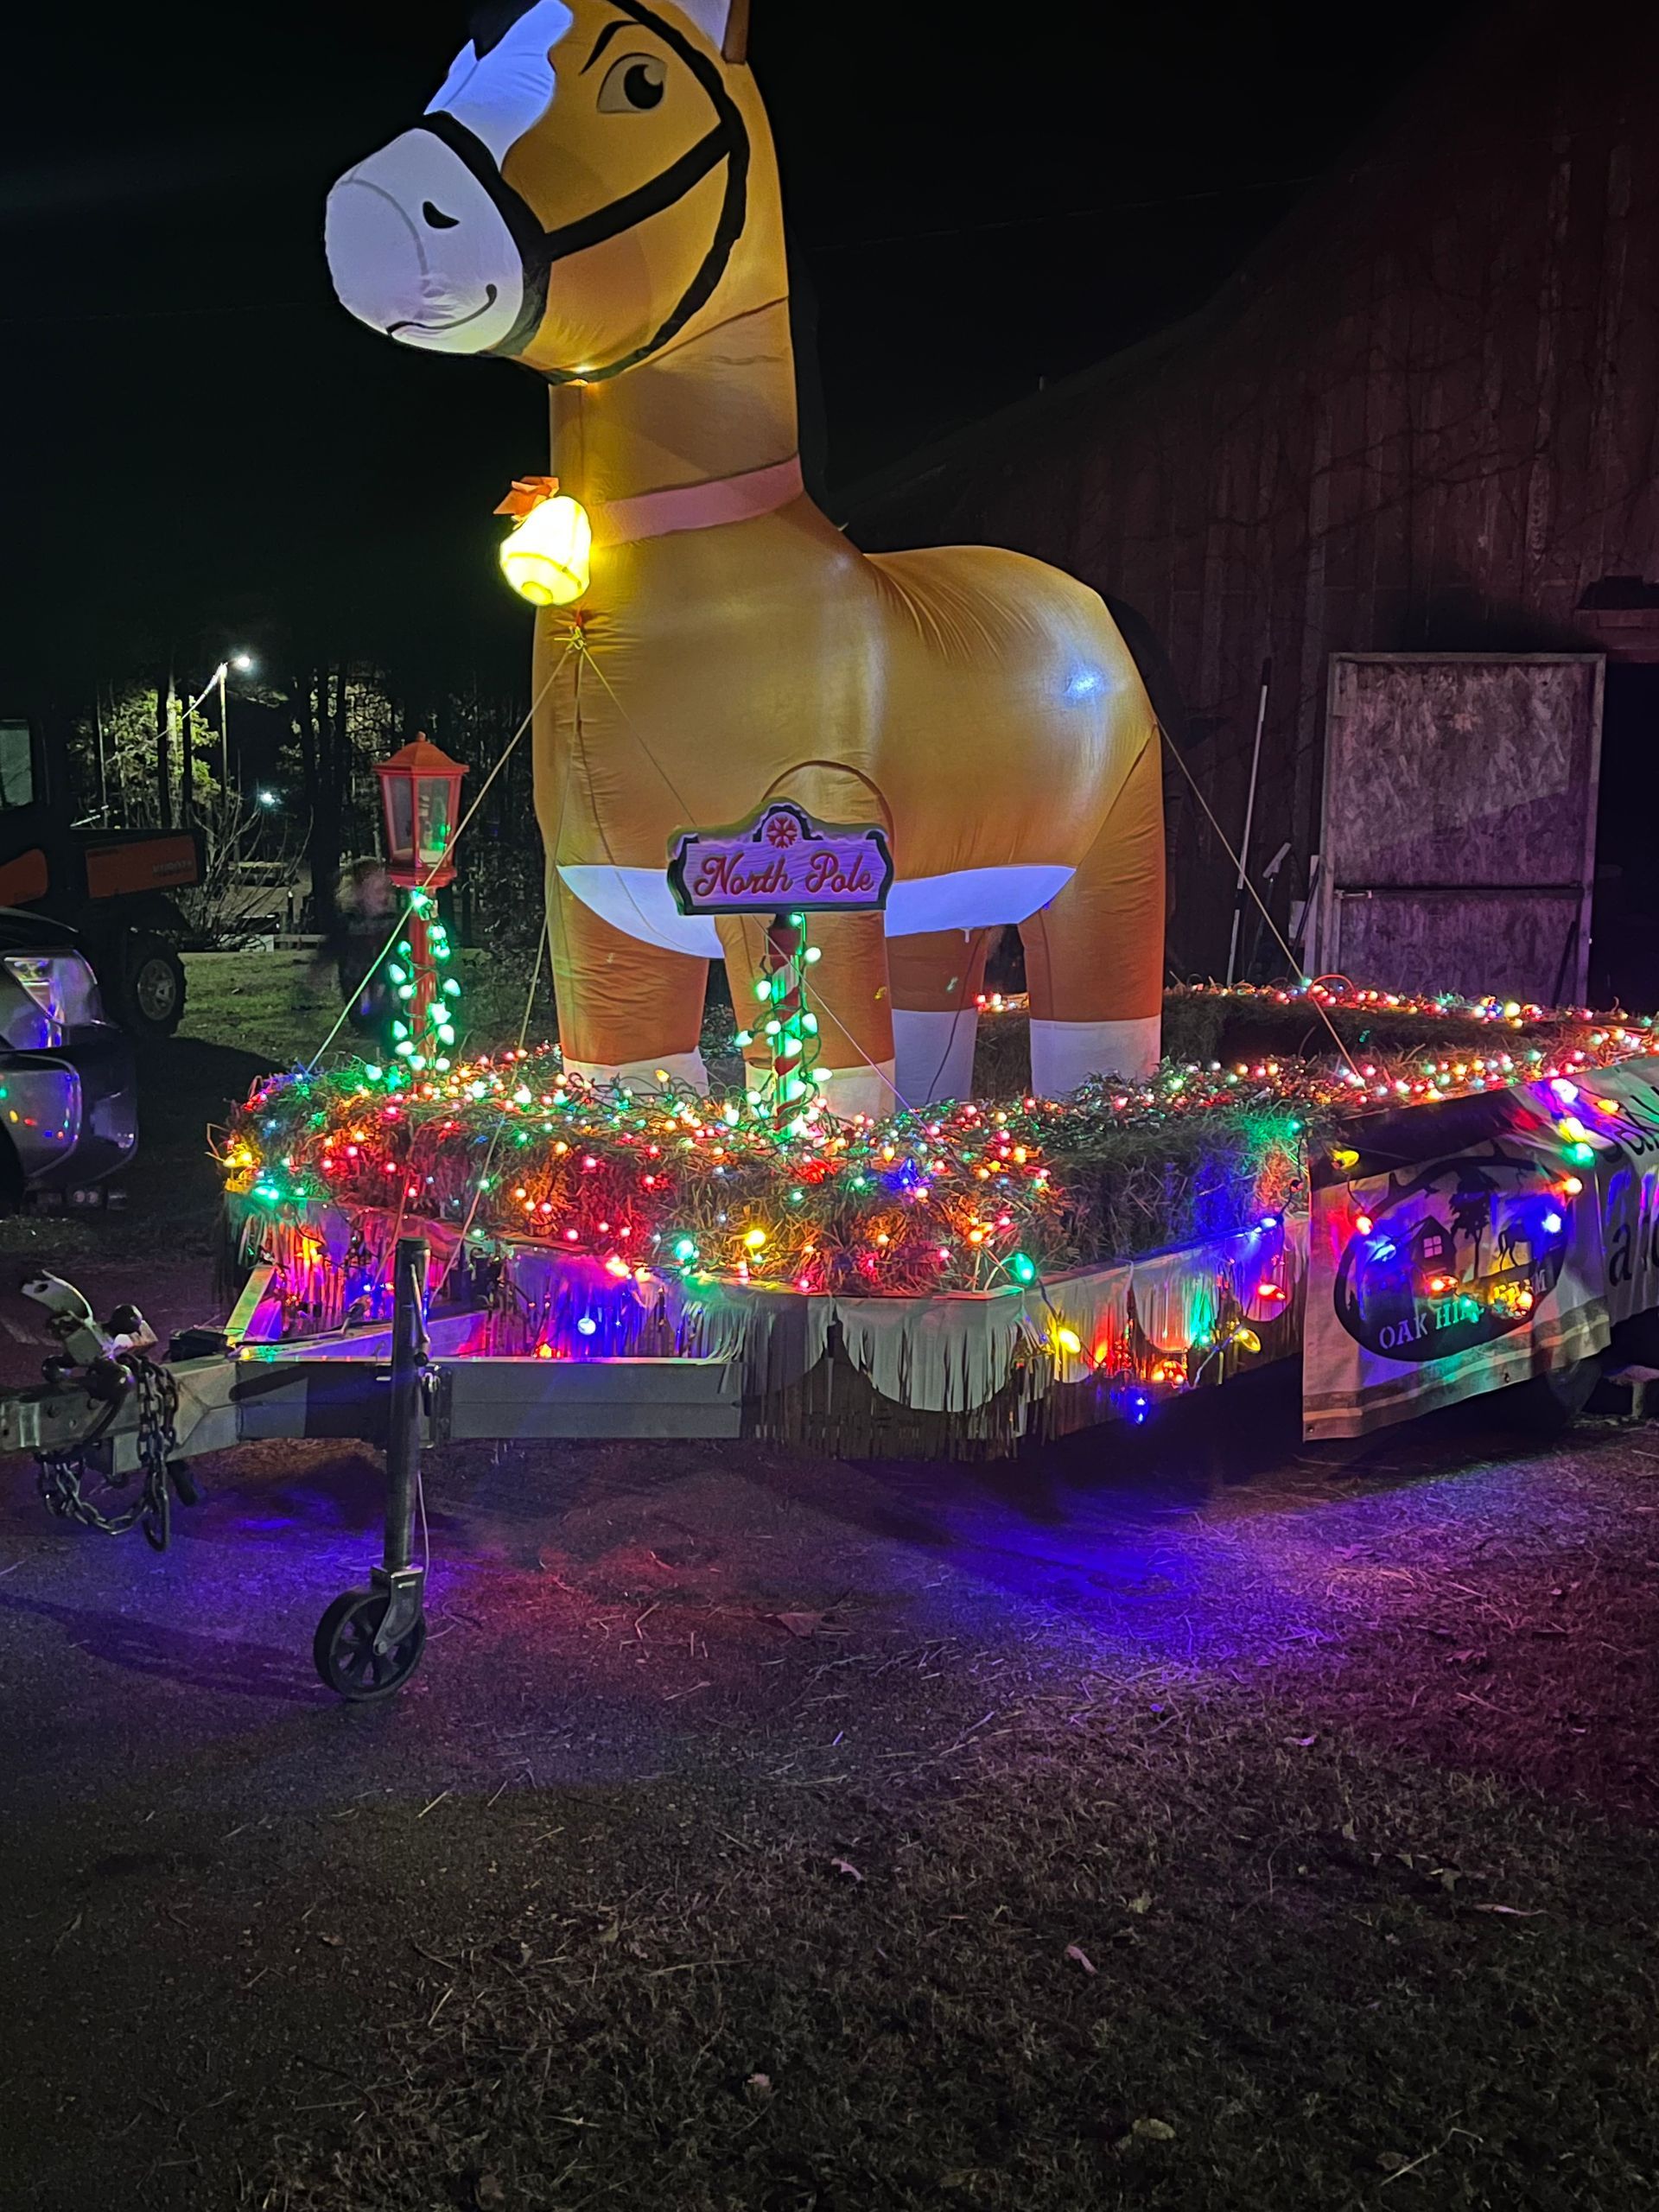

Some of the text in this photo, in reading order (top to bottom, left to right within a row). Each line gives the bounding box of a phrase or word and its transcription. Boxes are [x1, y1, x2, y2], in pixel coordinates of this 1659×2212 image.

[693, 850, 875, 897] North Pole
[1379, 1313, 1428, 1350] OAK
